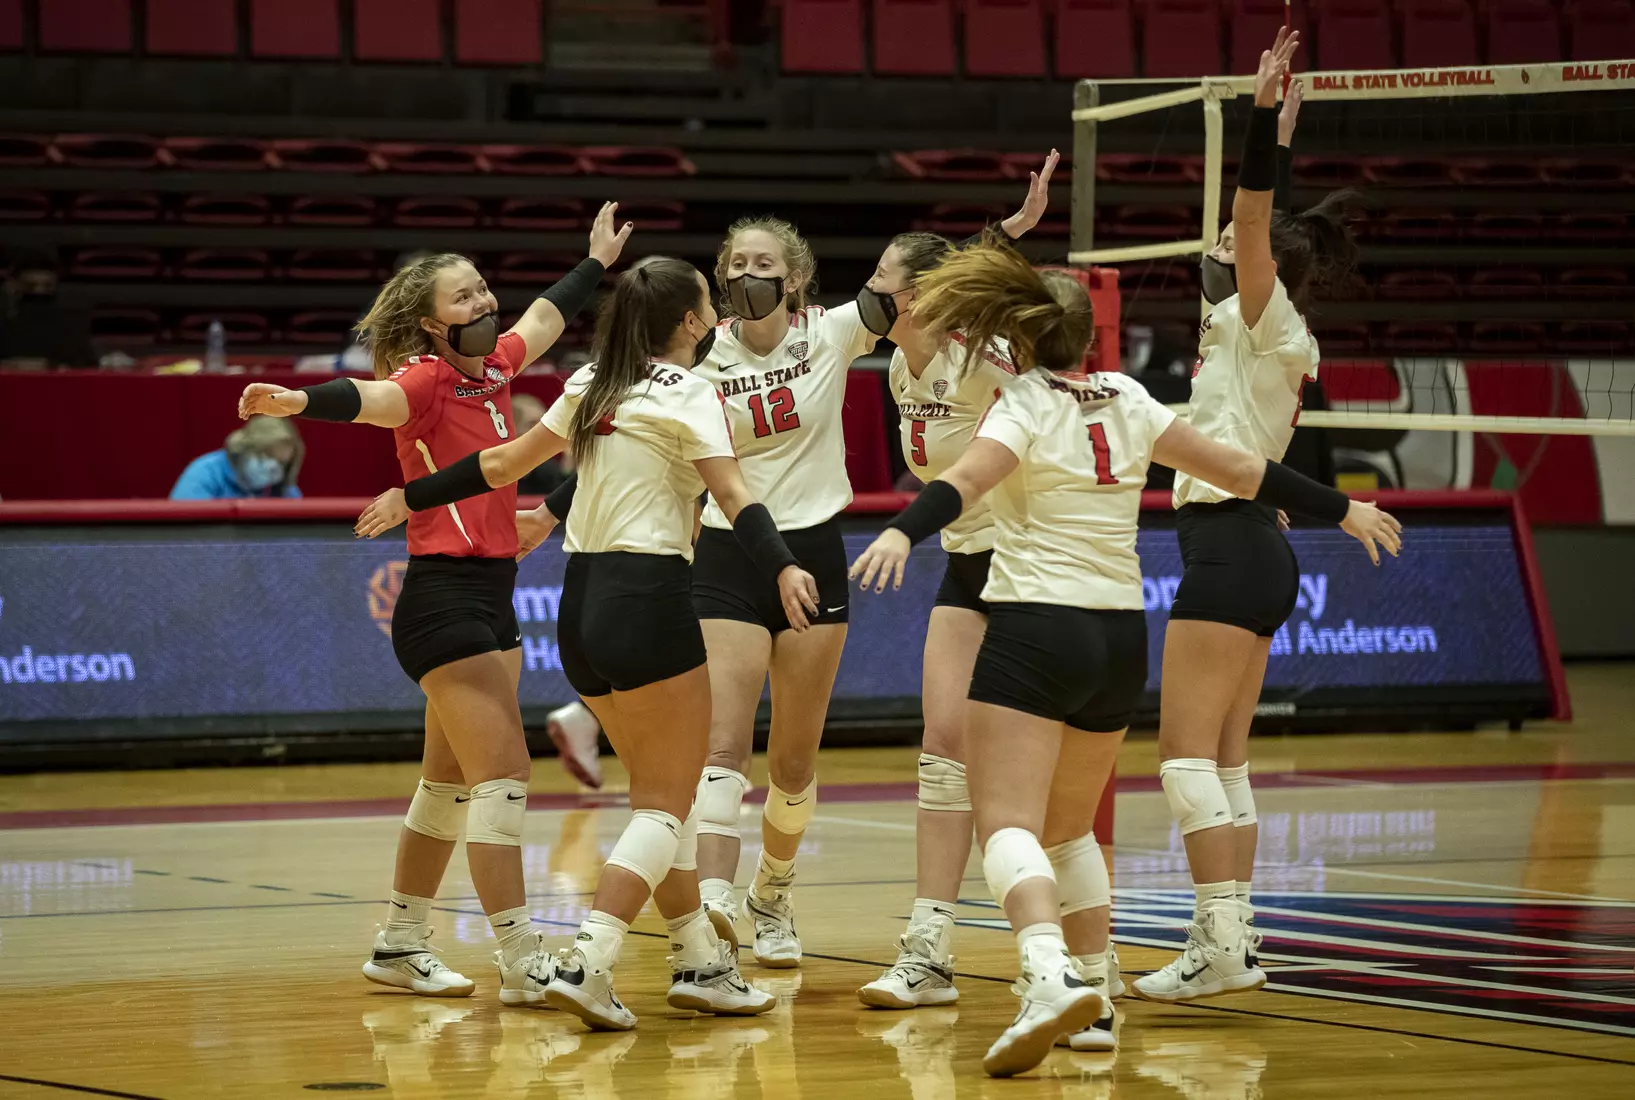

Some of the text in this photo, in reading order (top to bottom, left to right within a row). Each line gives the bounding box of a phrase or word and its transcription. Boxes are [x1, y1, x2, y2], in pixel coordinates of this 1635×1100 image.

[1313, 69, 1495, 91] BALL STATE VOLLEYBALL
[1562, 65, 1604, 81] BALL
[455, 384, 488, 398] BALL
[721, 359, 811, 397] BALL STATE
[484, 399, 509, 439] 6
[747, 386, 801, 438] 12
[911, 420, 928, 466] 5
[1086, 422, 1119, 485] 1
[1298, 619, 1438, 655] Anderson
